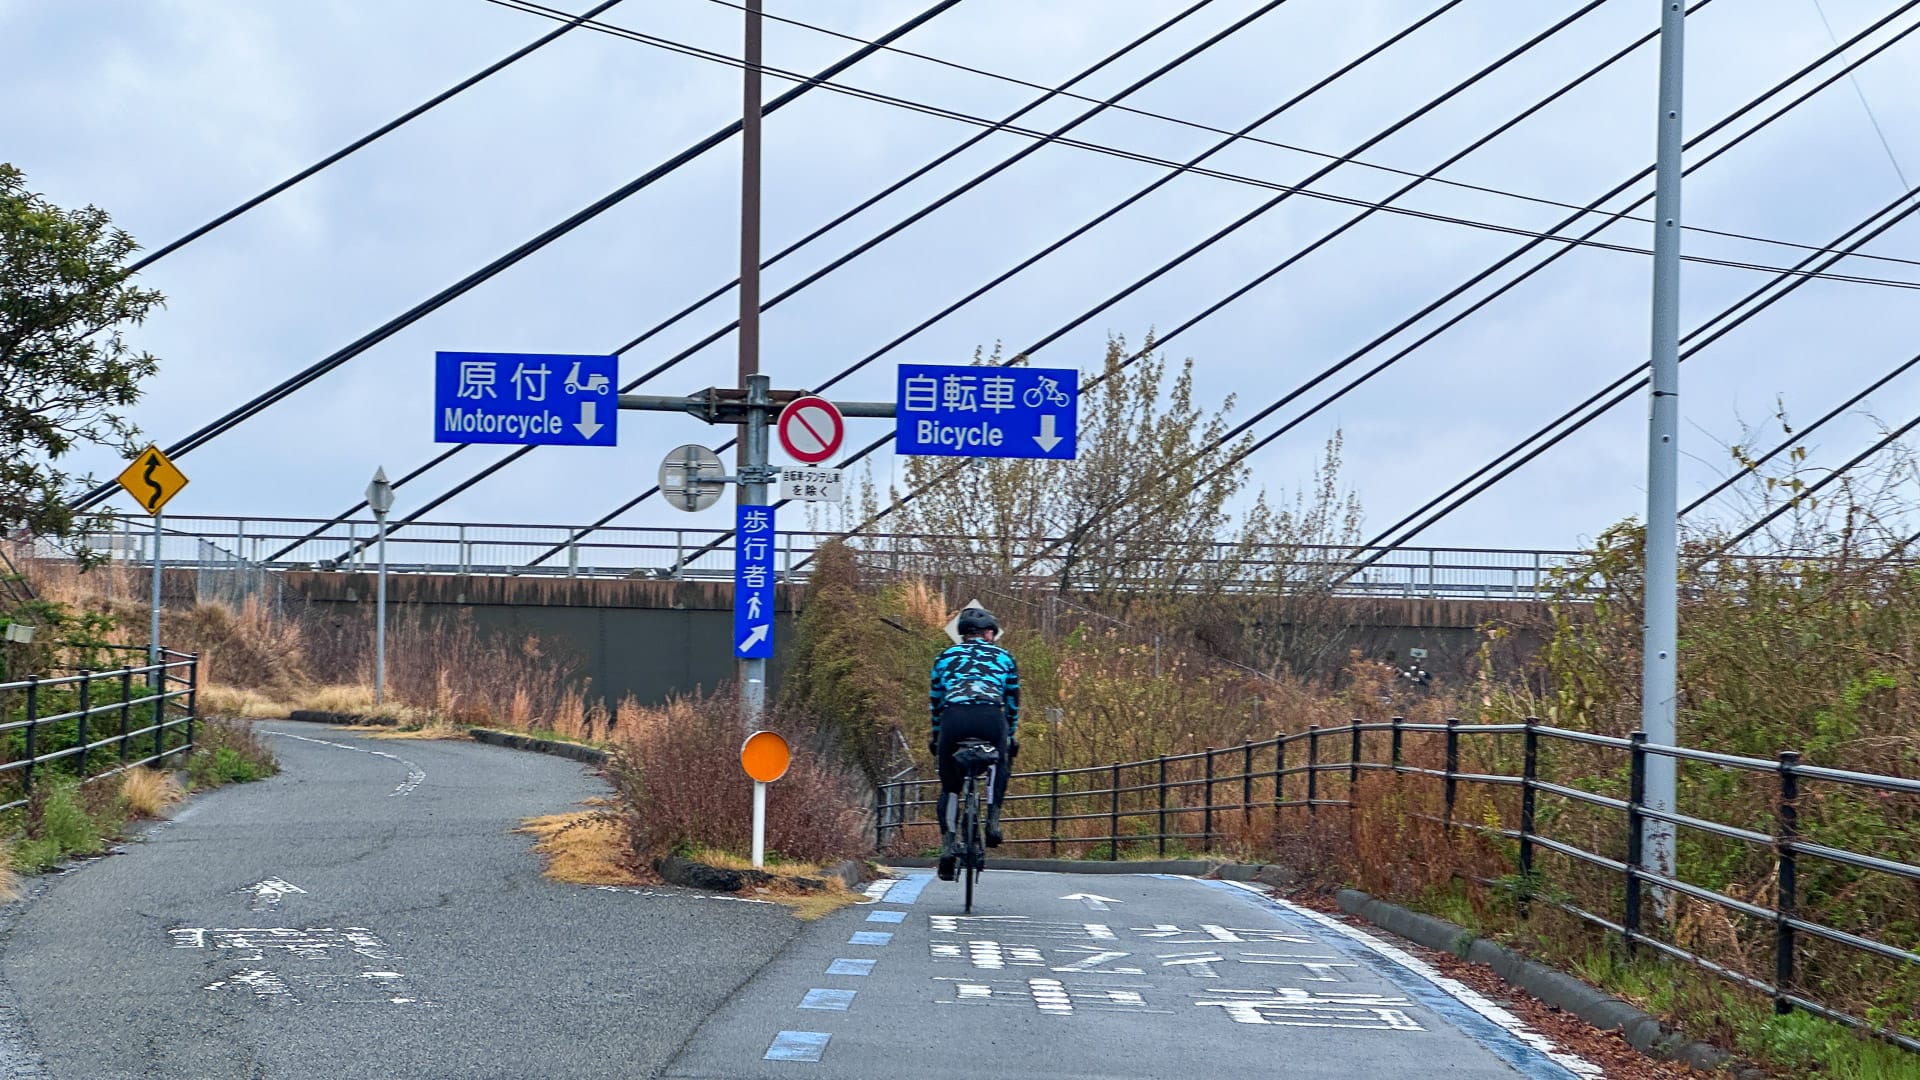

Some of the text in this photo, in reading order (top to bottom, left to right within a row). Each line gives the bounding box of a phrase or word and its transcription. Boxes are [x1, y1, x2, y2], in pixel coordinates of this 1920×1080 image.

[457, 361, 552, 401] 原付
[905, 373, 1016, 414] 自転車
[444, 407, 563, 438] Motorcycle
[917, 419, 1003, 450] Bicycle
[792, 484, 827, 497] を除く
[743, 510, 769, 588] 歩行者
